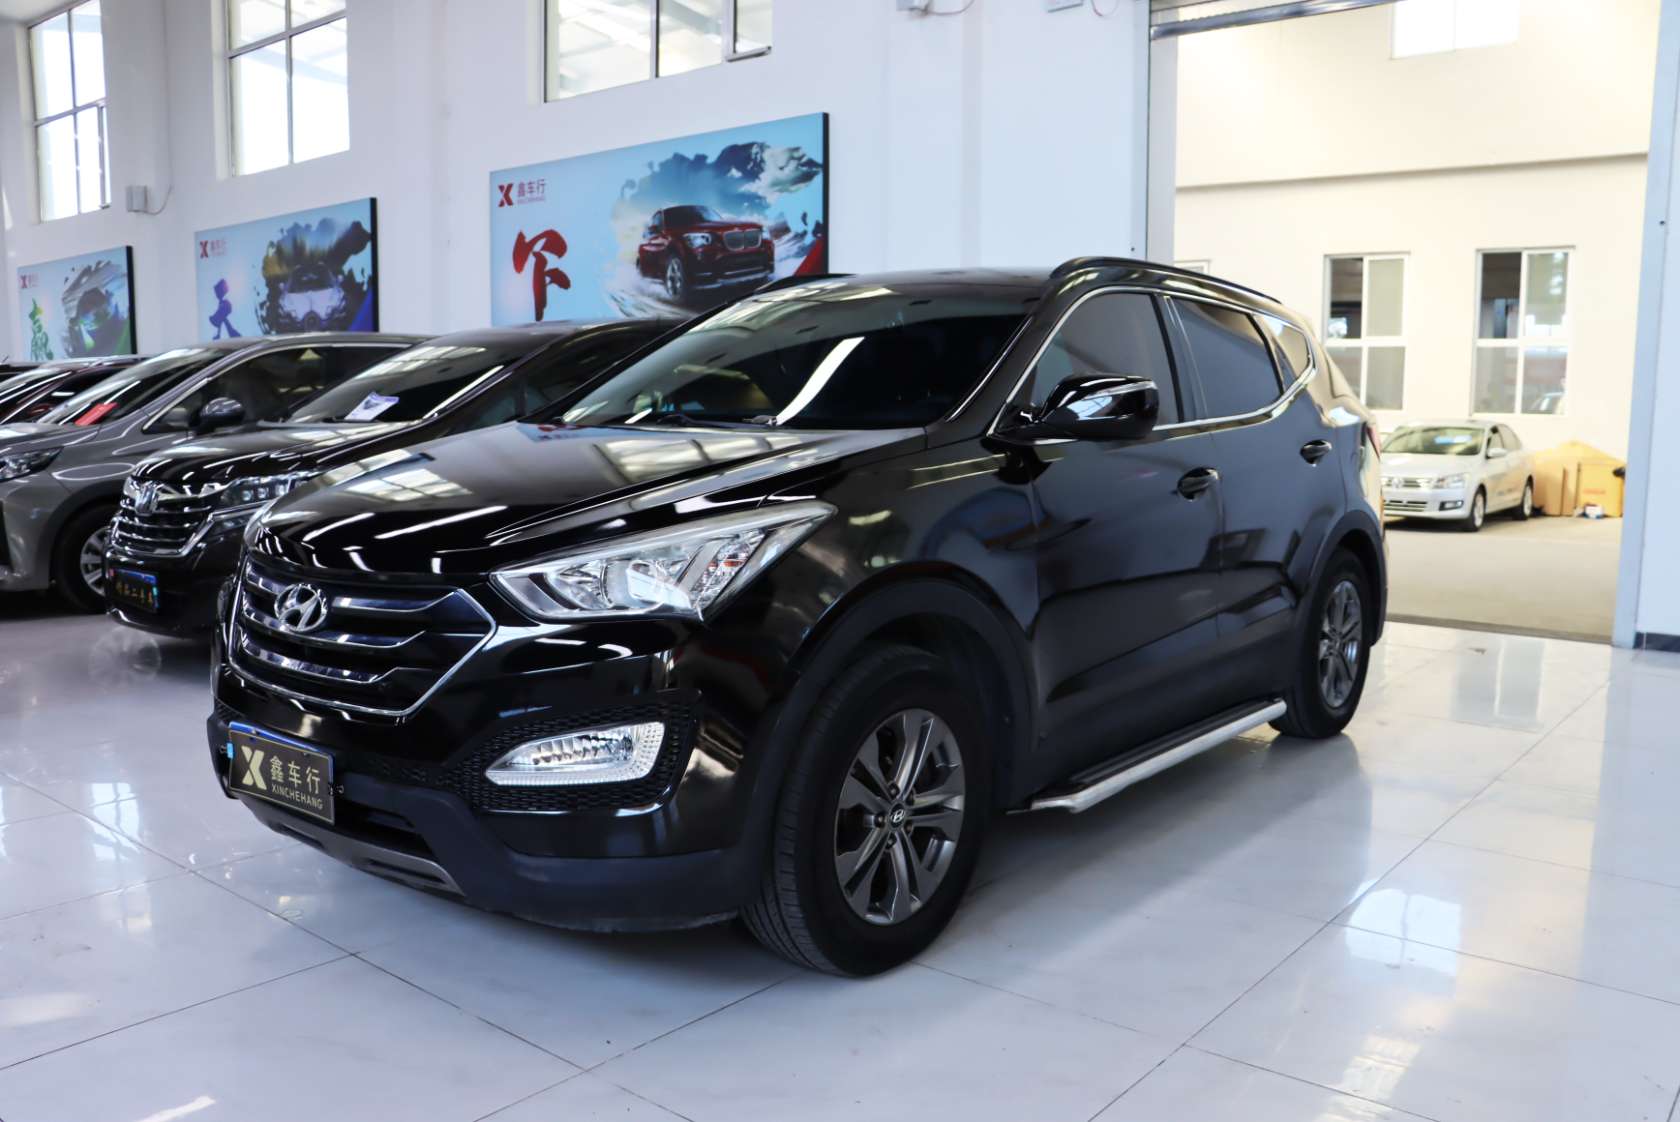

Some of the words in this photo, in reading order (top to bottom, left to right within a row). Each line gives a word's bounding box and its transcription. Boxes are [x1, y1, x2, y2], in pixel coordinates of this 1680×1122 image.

[270, 755, 321, 794] 鑫车行
[271, 783, 323, 810] XINCHEHANG
